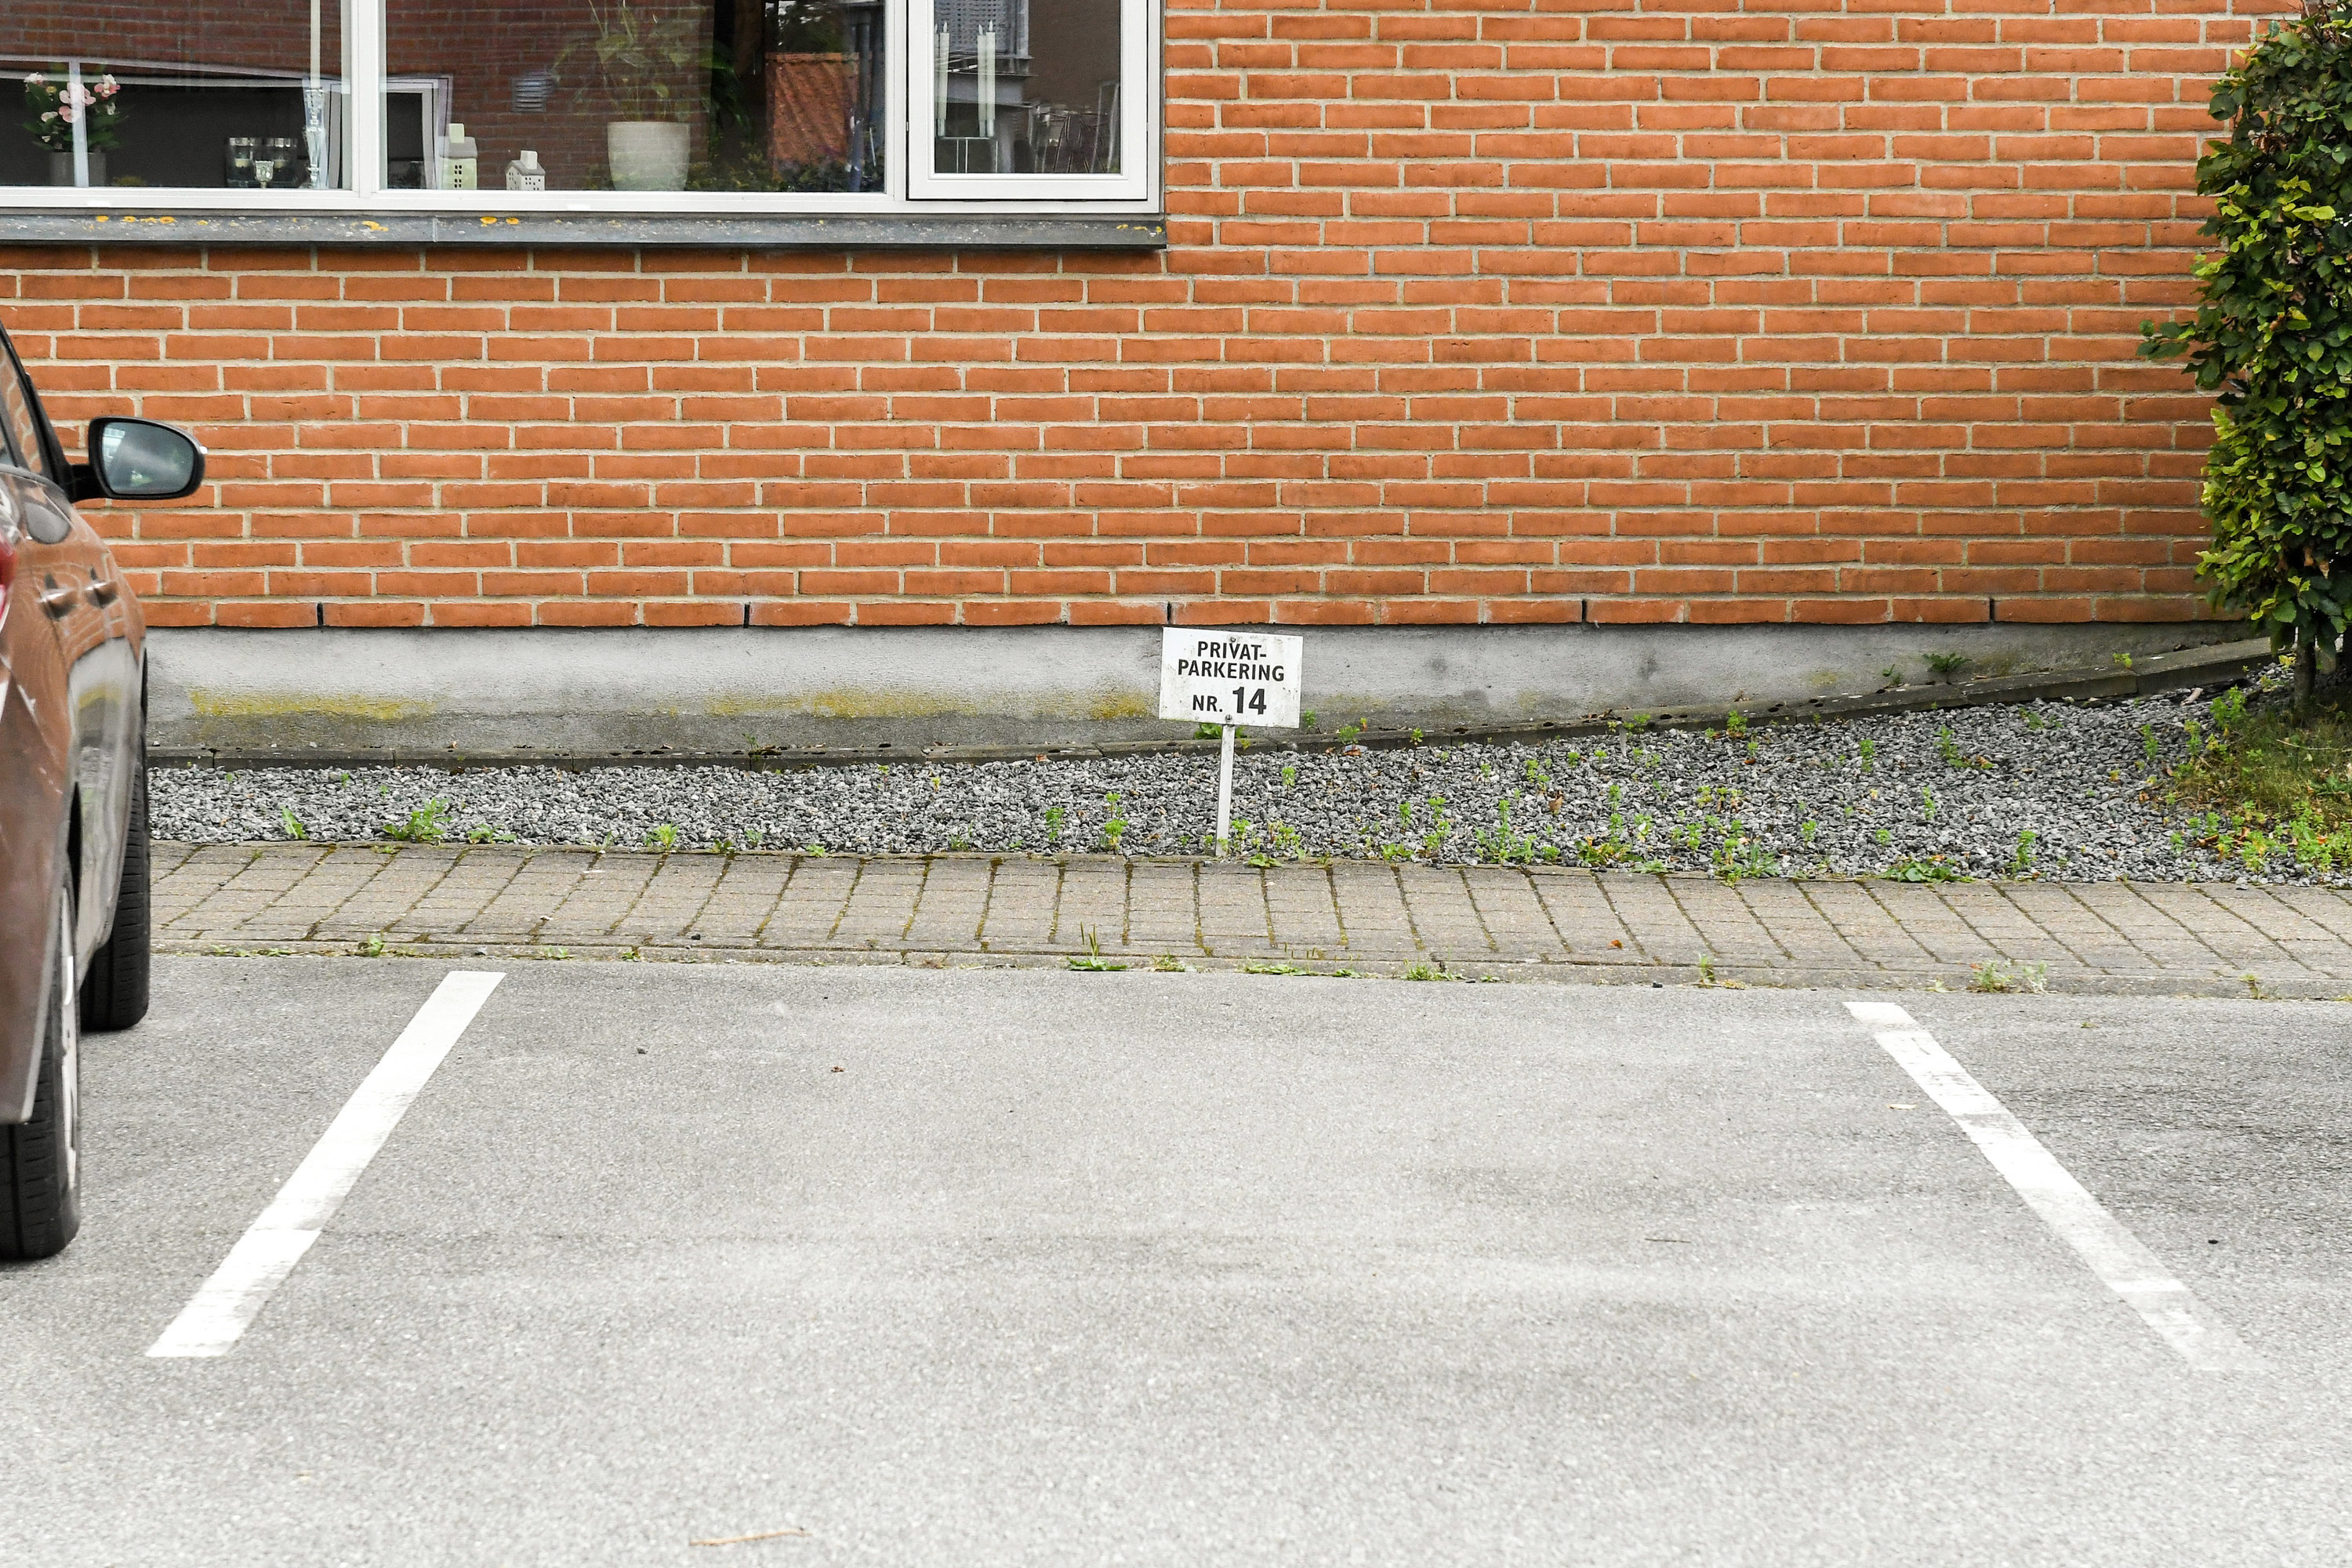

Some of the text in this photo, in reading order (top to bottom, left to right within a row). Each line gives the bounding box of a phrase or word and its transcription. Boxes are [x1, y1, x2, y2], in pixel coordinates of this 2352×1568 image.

[1197, 641, 1267, 661] PRIVAT-
[1178, 659, 1284, 682] PARKERING
[1192, 686, 1267, 715] NR. 14
